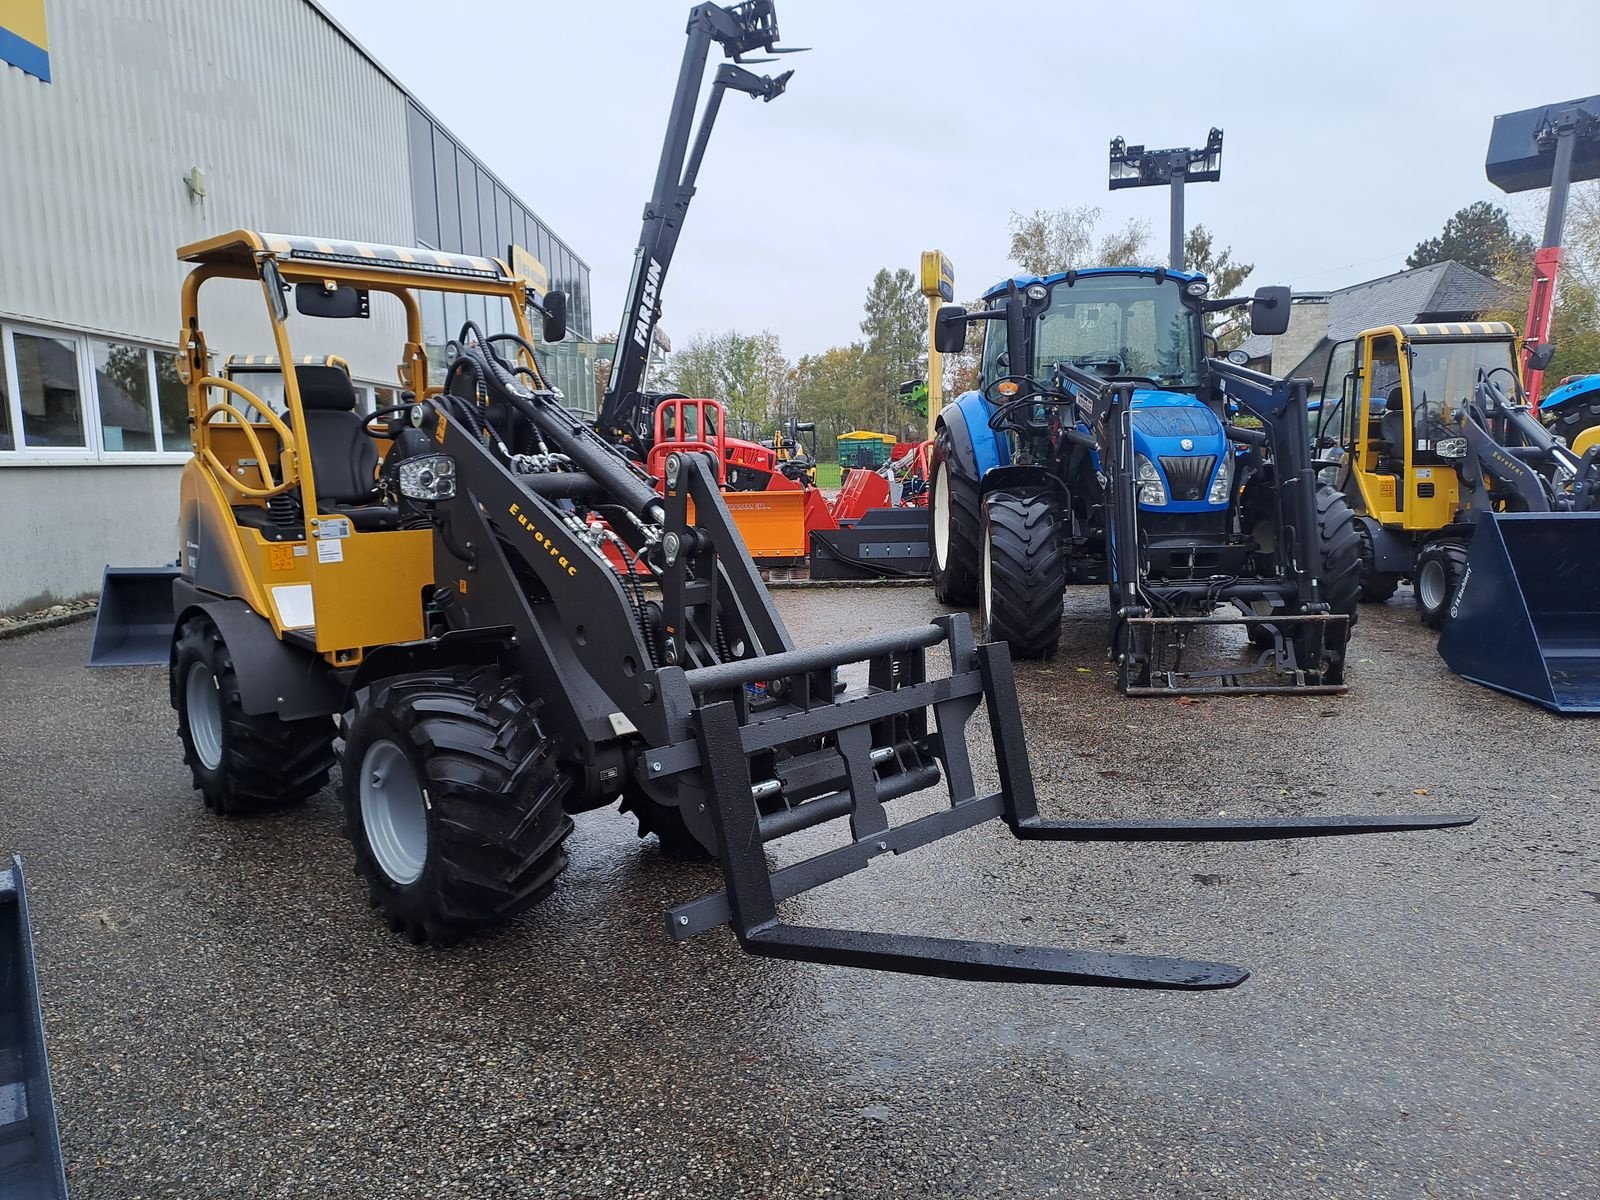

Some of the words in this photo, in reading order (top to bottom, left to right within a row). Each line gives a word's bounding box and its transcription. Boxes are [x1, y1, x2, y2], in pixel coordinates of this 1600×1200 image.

[633, 256, 662, 349] FARESIN
[1492, 450, 1525, 477] Eurotrac
[508, 503, 577, 577] Eurotrac
